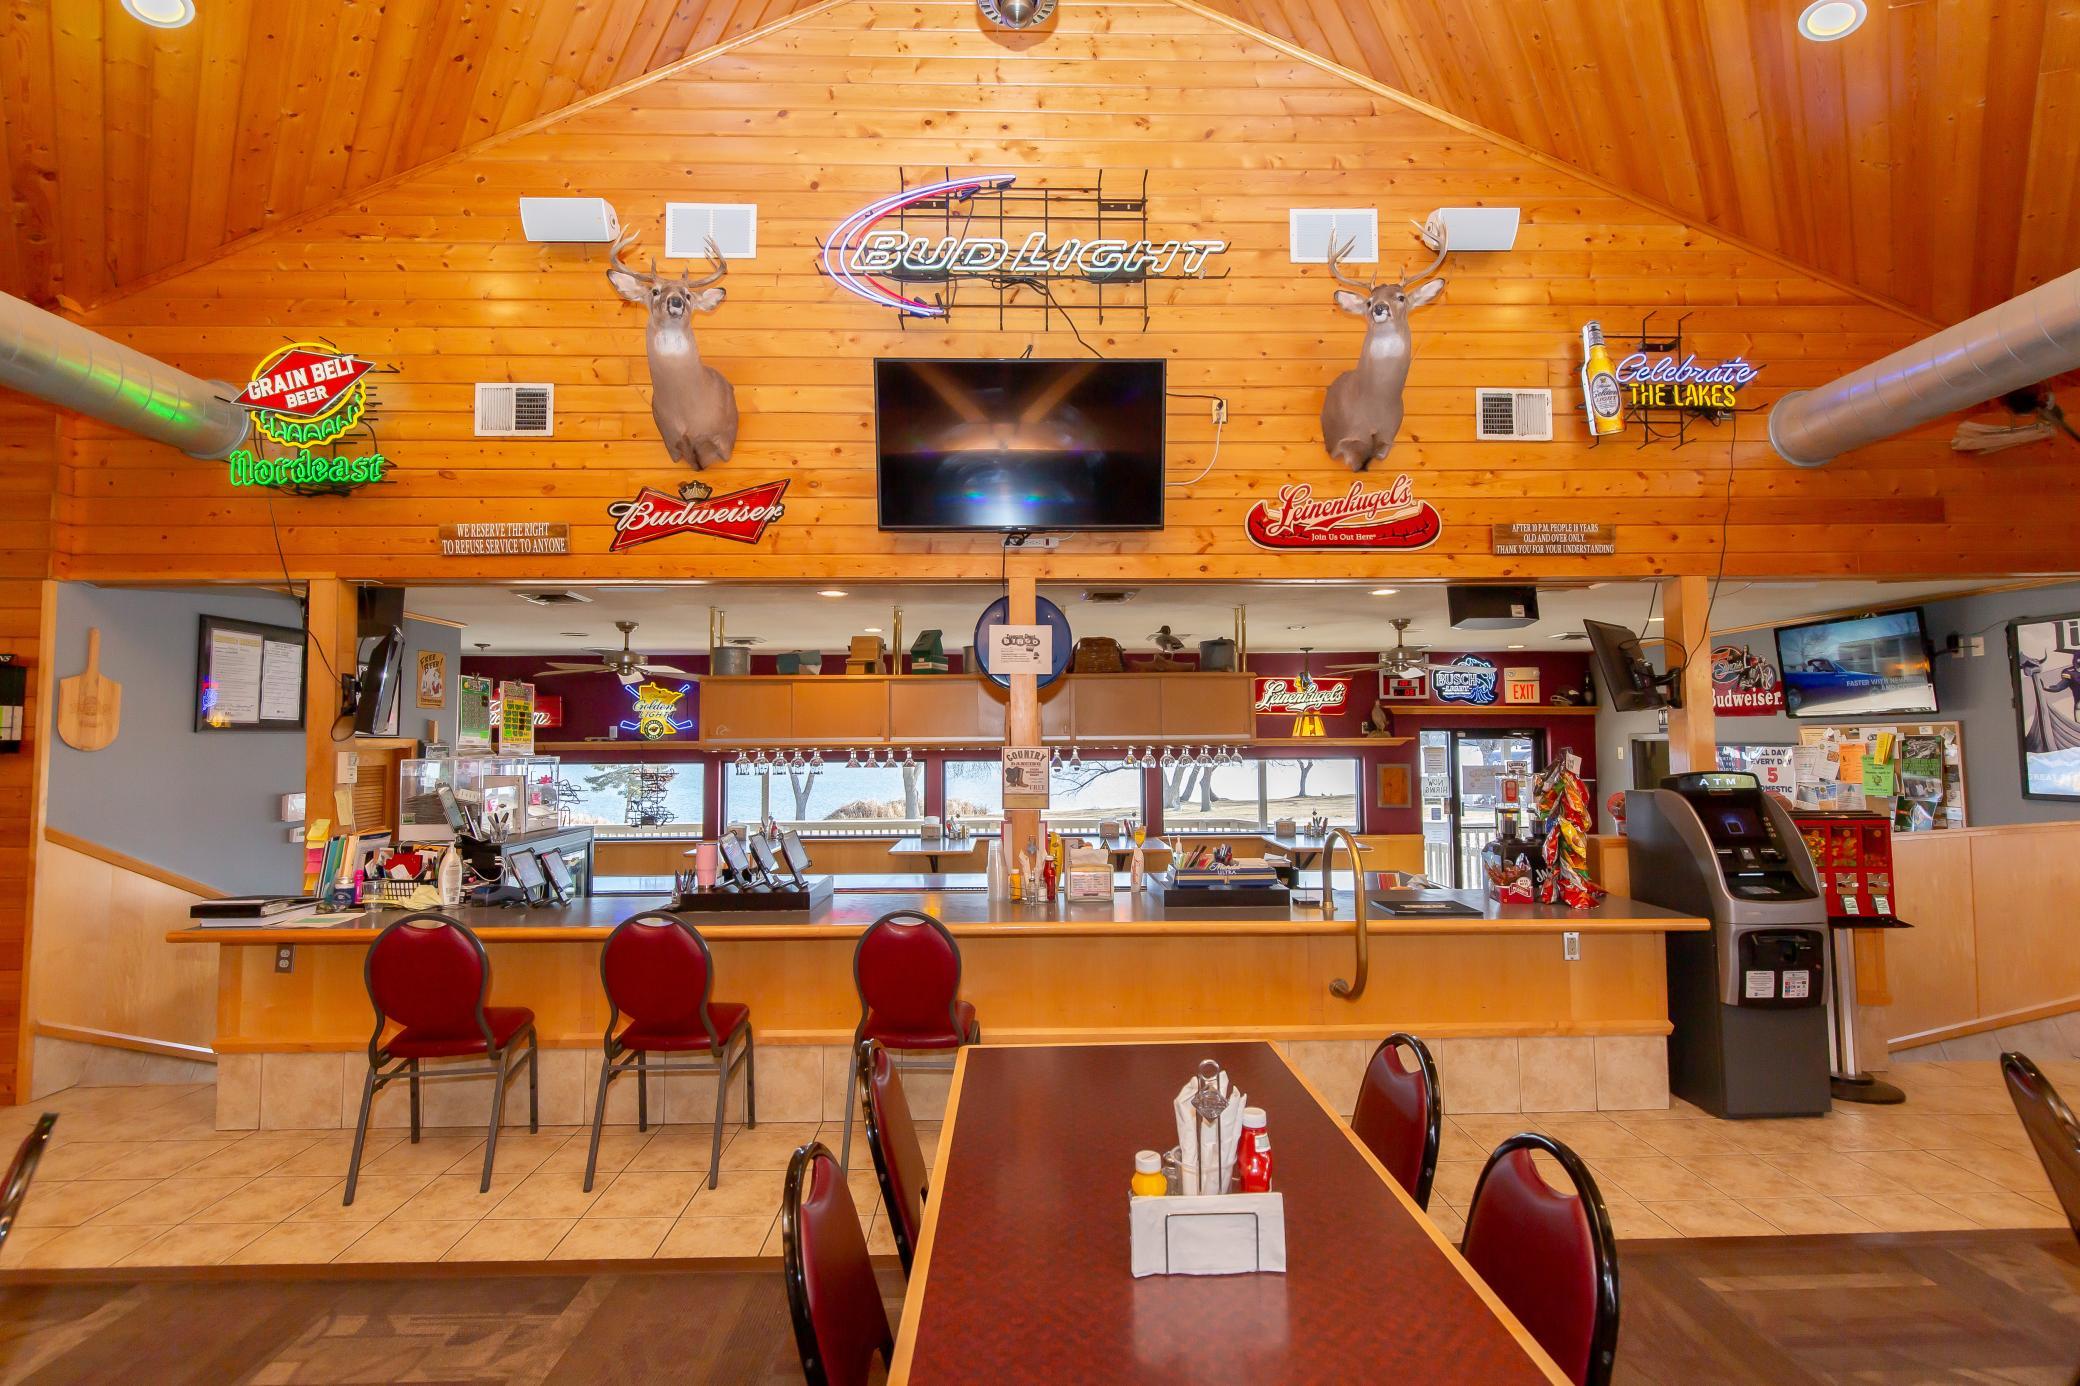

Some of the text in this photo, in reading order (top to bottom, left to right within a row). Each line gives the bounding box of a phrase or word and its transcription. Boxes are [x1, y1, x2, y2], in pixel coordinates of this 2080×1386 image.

[851, 230, 1226, 273] BUD LIGHT
[1615, 353, 1758, 383] Celebrate
[247, 354, 355, 401] GRAIN BELT
[284, 385, 329, 409] BEER
[1629, 383, 1666, 406] THE
[1673, 384, 1736, 407] LAKES
[229, 449, 385, 487] Nordeast
[1267, 473, 1413, 535] Leinenkugel's
[609, 499, 783, 532] Budweiser
[457, 522, 550, 538] WE RESERVE THE RIGHT
[1511, 523, 1599, 533] AFTER 10 P.M. PEOPLE 18 YEARS
[442, 537, 566, 555] TO REFUSE SERVICE TO ANYONE
[1311, 533, 1327, 542] Join
[1328, 533, 1338, 541] Us
[1339, 533, 1354, 541] Out
[1523, 533, 1537, 543] OLD
[1537, 533, 1551, 543] AND
[1551, 533, 1568, 543] OVER
[1496, 544, 1615, 554] THANK YOU FOR YOUR UNDERSTANDING
[1436, 673, 1478, 687] BUSCH
[1846, 679, 1870, 688] FASTER
[1255, 679, 1346, 712] Leinenkugel's
[1512, 683, 1535, 700] EXIT
[632, 700, 675, 712] Golden
[1006, 750, 1047, 762] COUNTRY
[1699, 778, 1736, 786] ATM
[1767, 766, 1779, 783] 5
[1760, 785, 1793, 793] OMESTIC
